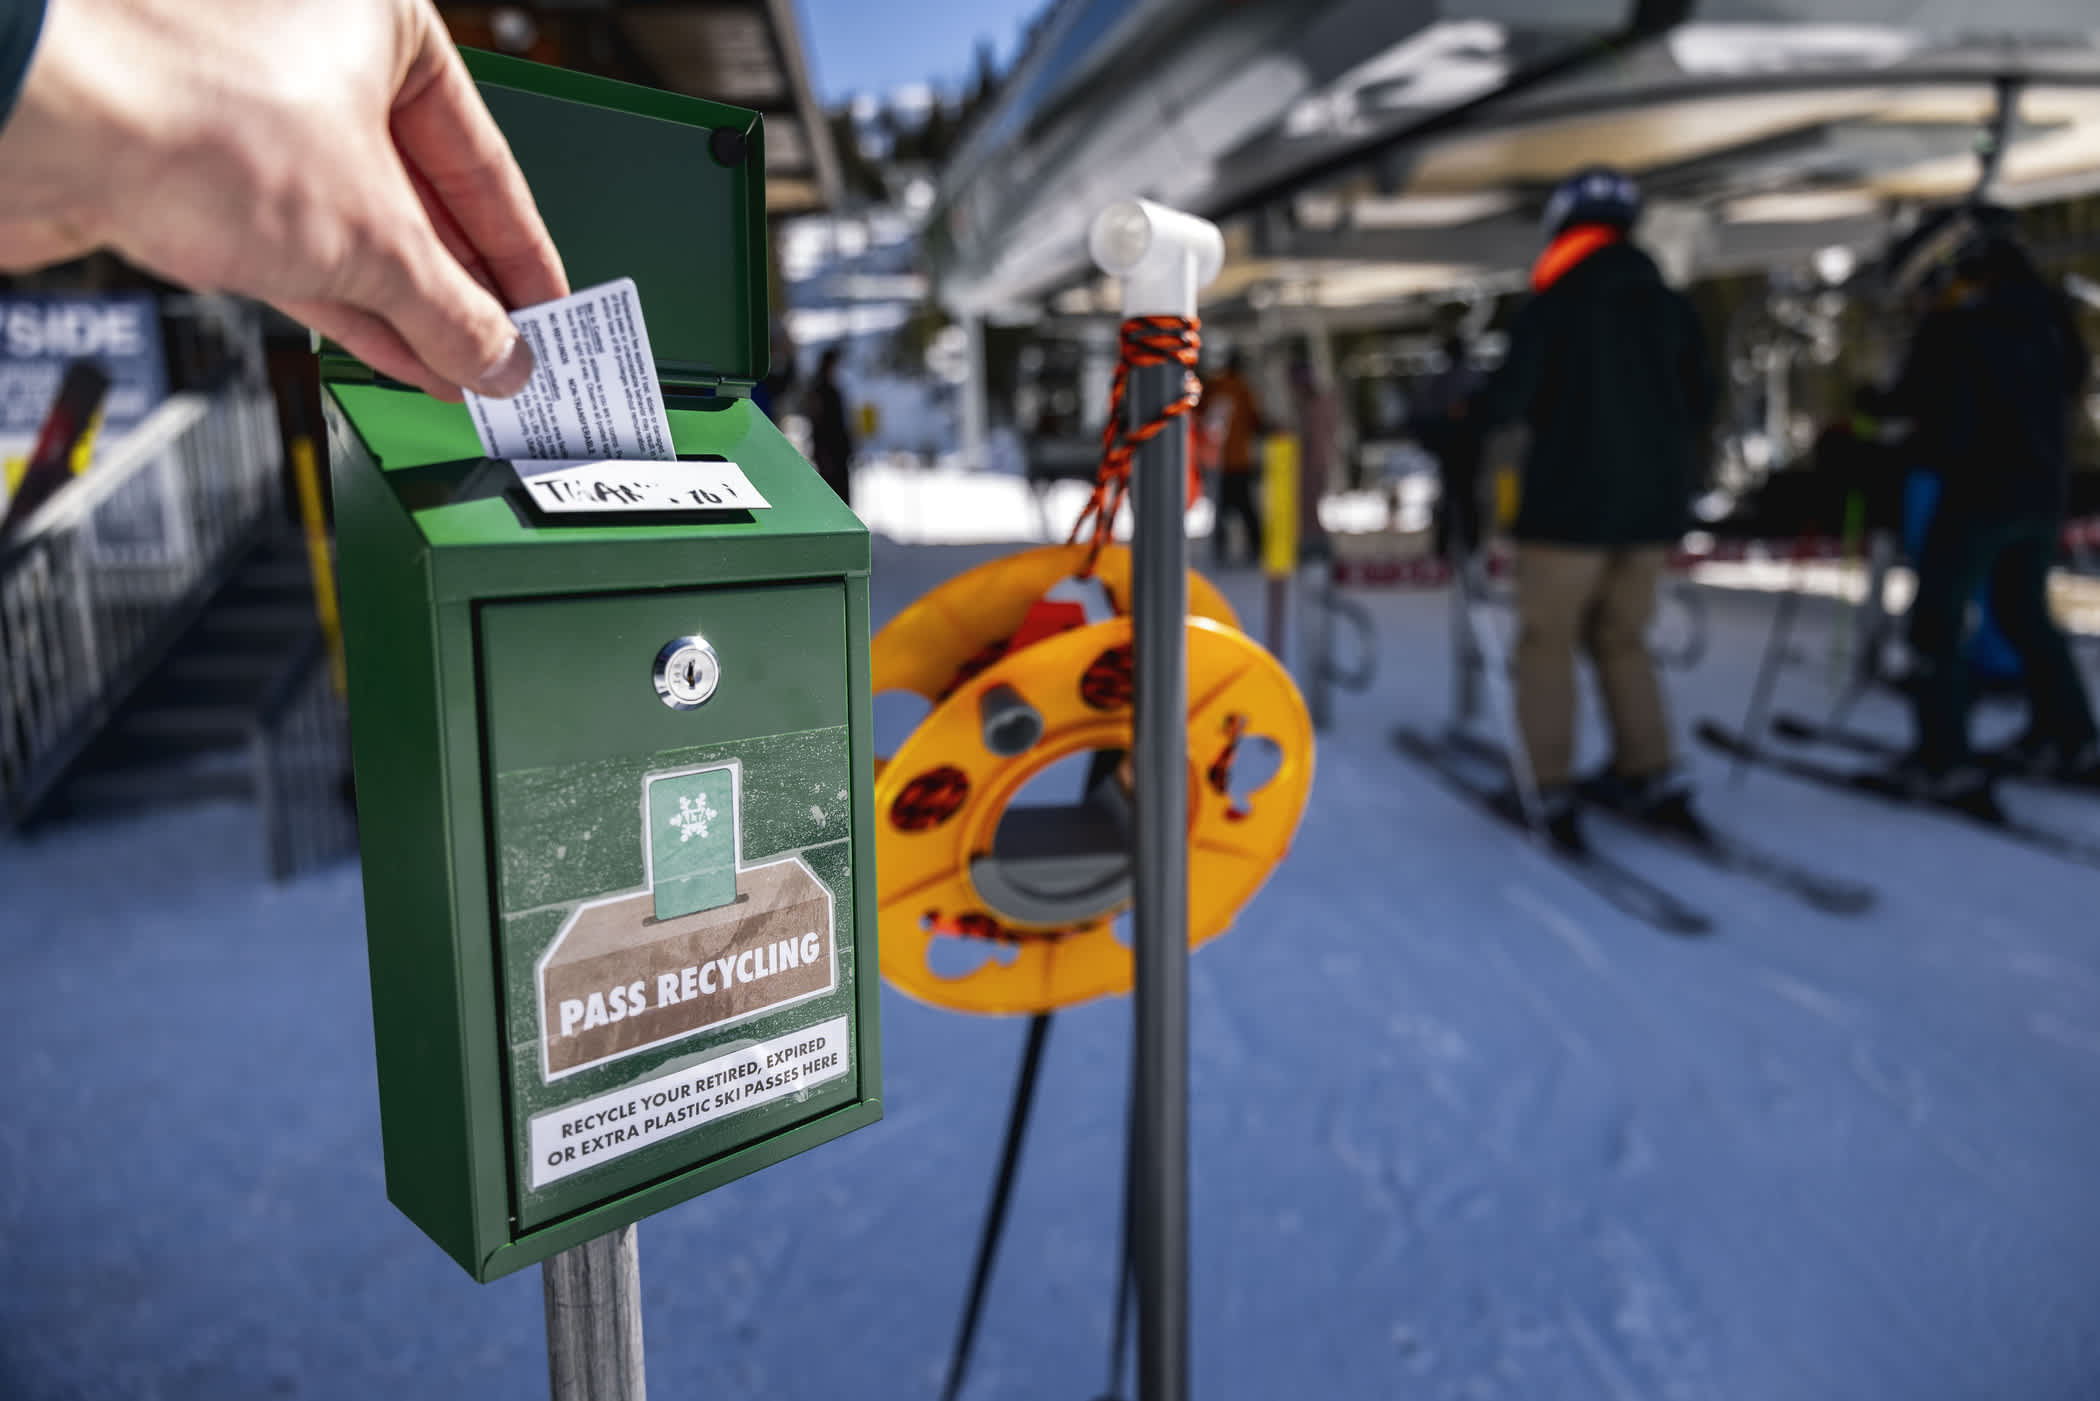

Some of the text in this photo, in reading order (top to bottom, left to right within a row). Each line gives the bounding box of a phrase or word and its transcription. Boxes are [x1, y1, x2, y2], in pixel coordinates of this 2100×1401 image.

[0, 303, 145, 357] SIDE
[559, 931, 821, 1038] PASS RECYCLING
[547, 1052, 839, 1167] OR EXTRA PLASTIC SKI PASSES HERE
[561, 1037, 827, 1139] RECYCLE YOUR RETIRED, EXPIRED
